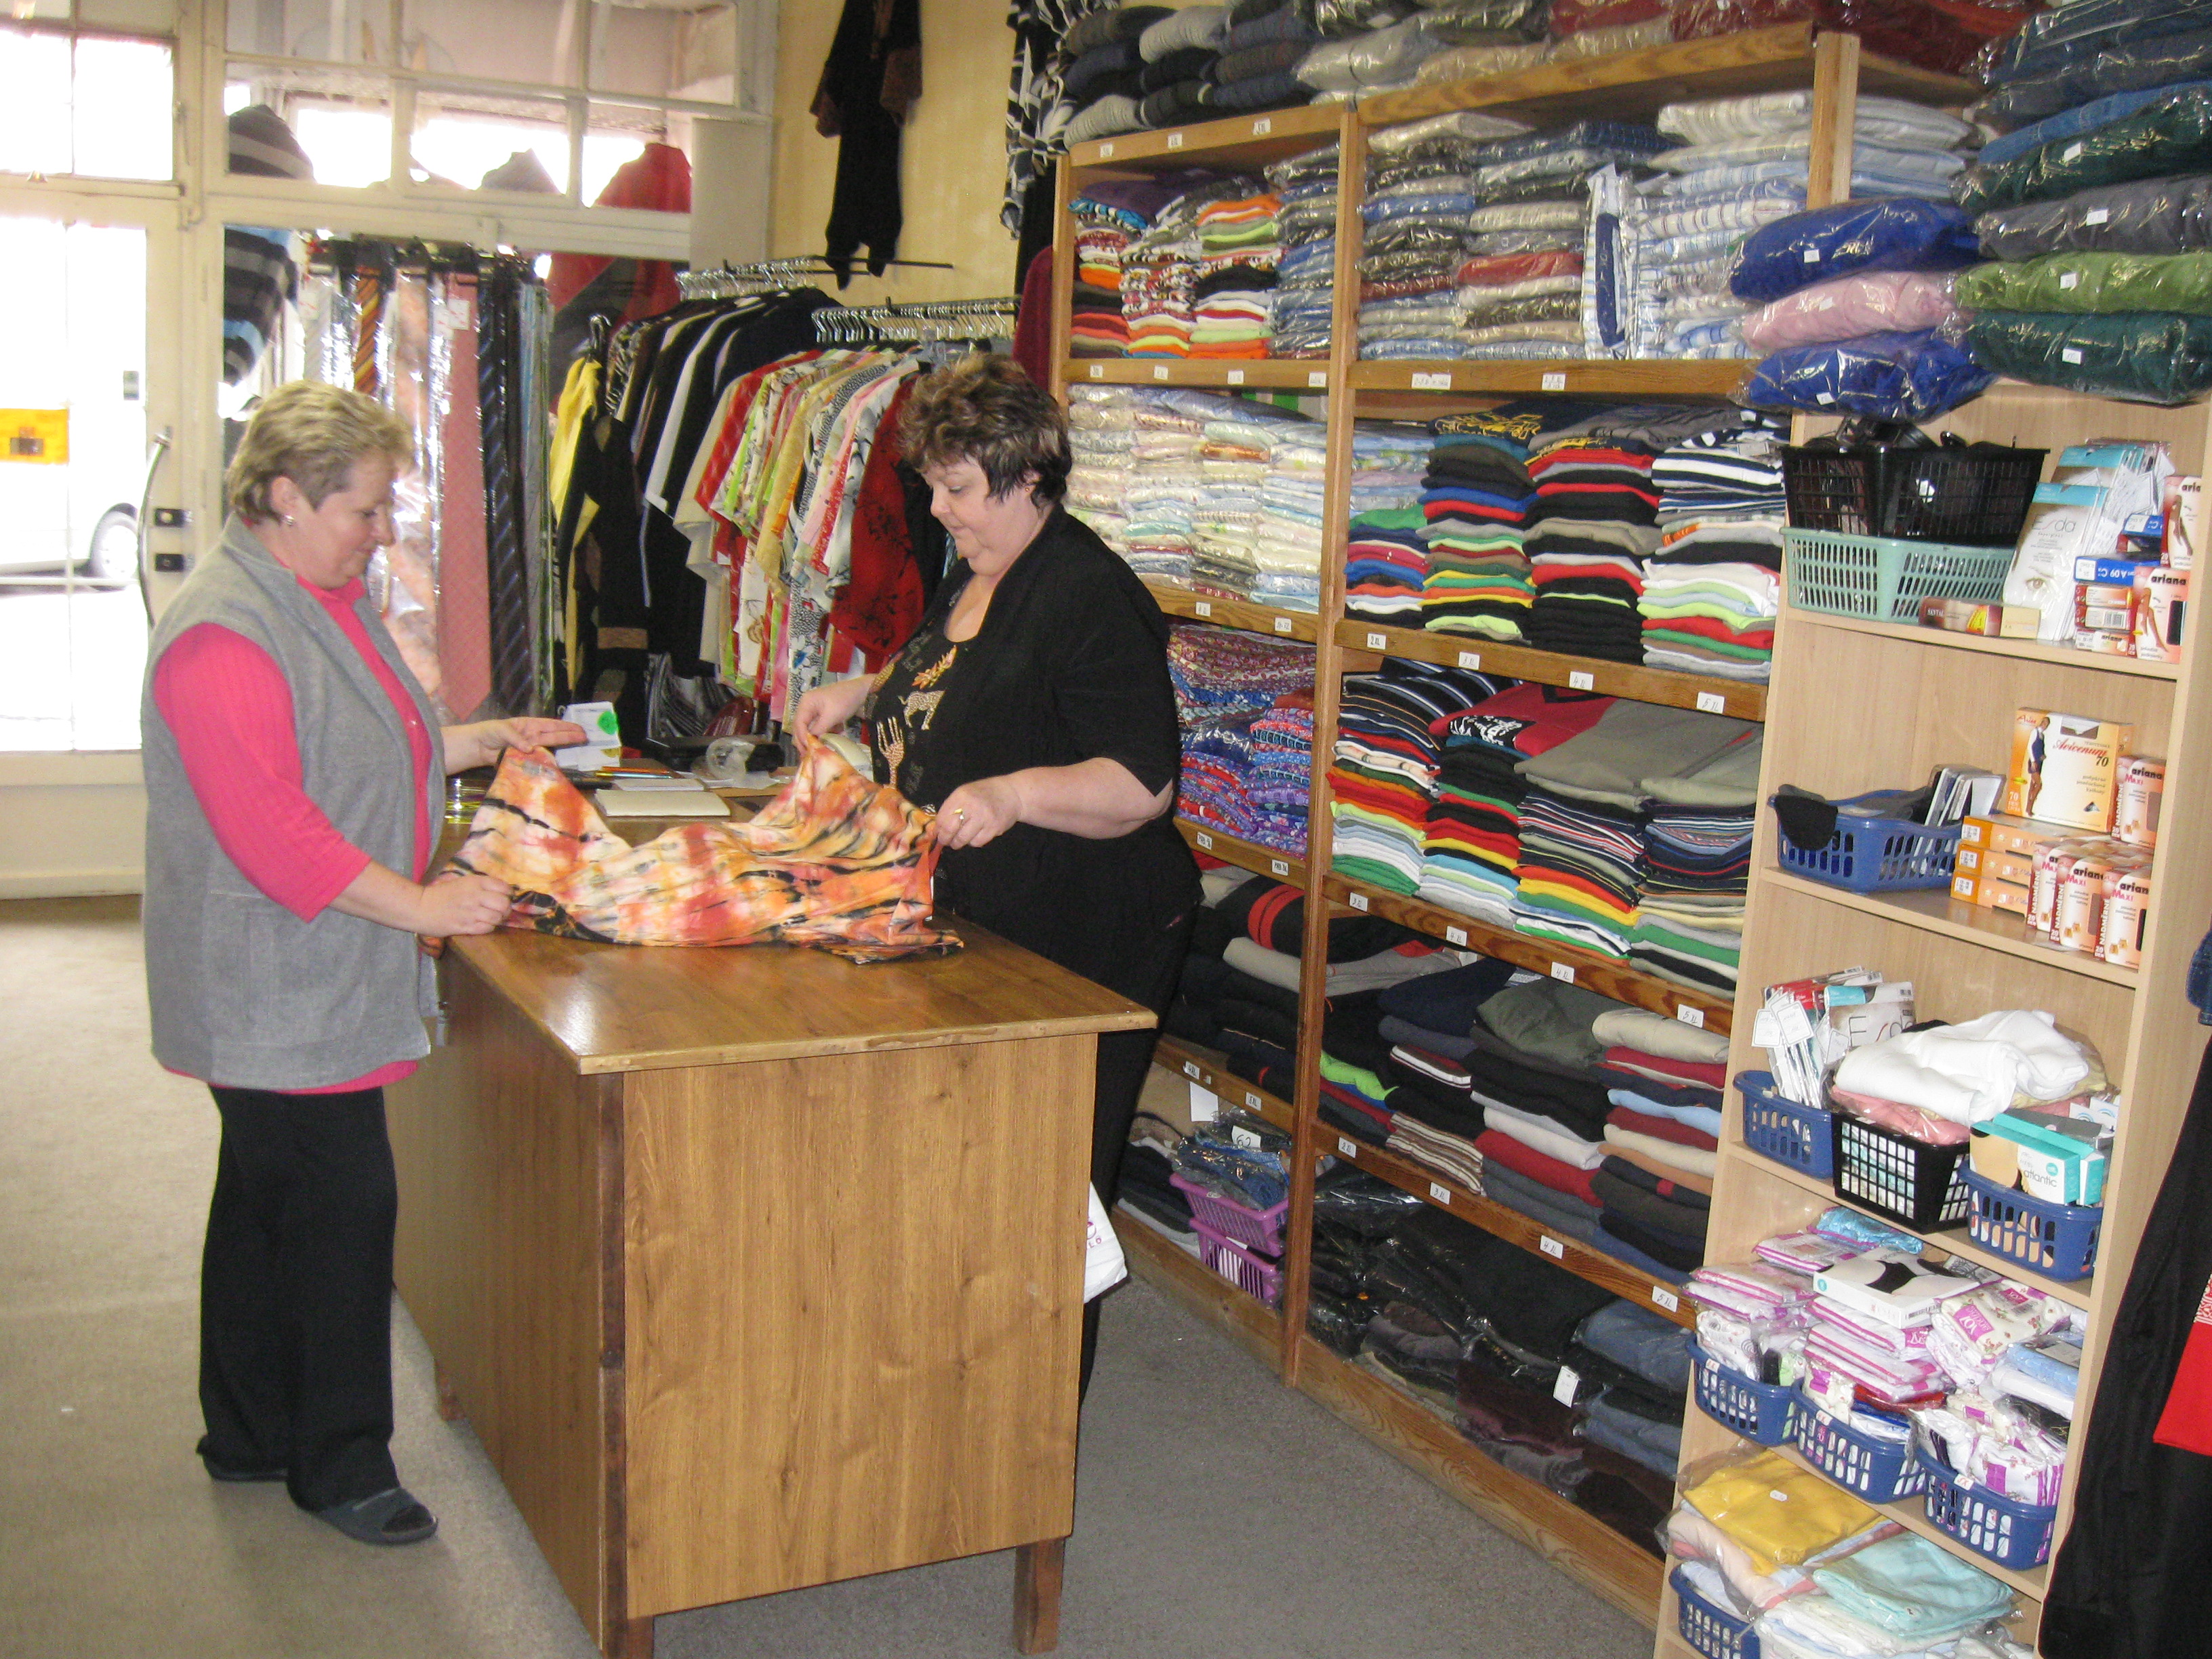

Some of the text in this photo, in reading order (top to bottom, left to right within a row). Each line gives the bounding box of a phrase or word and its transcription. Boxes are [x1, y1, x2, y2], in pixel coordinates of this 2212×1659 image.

[2151, 574, 2187, 586] ariana
[2053, 738, 2108, 757] Avicenum
[2095, 755, 2109, 767] 70
[2131, 766, 2163, 780] ariana
[2024, 1169, 2057, 1188] atlantic
